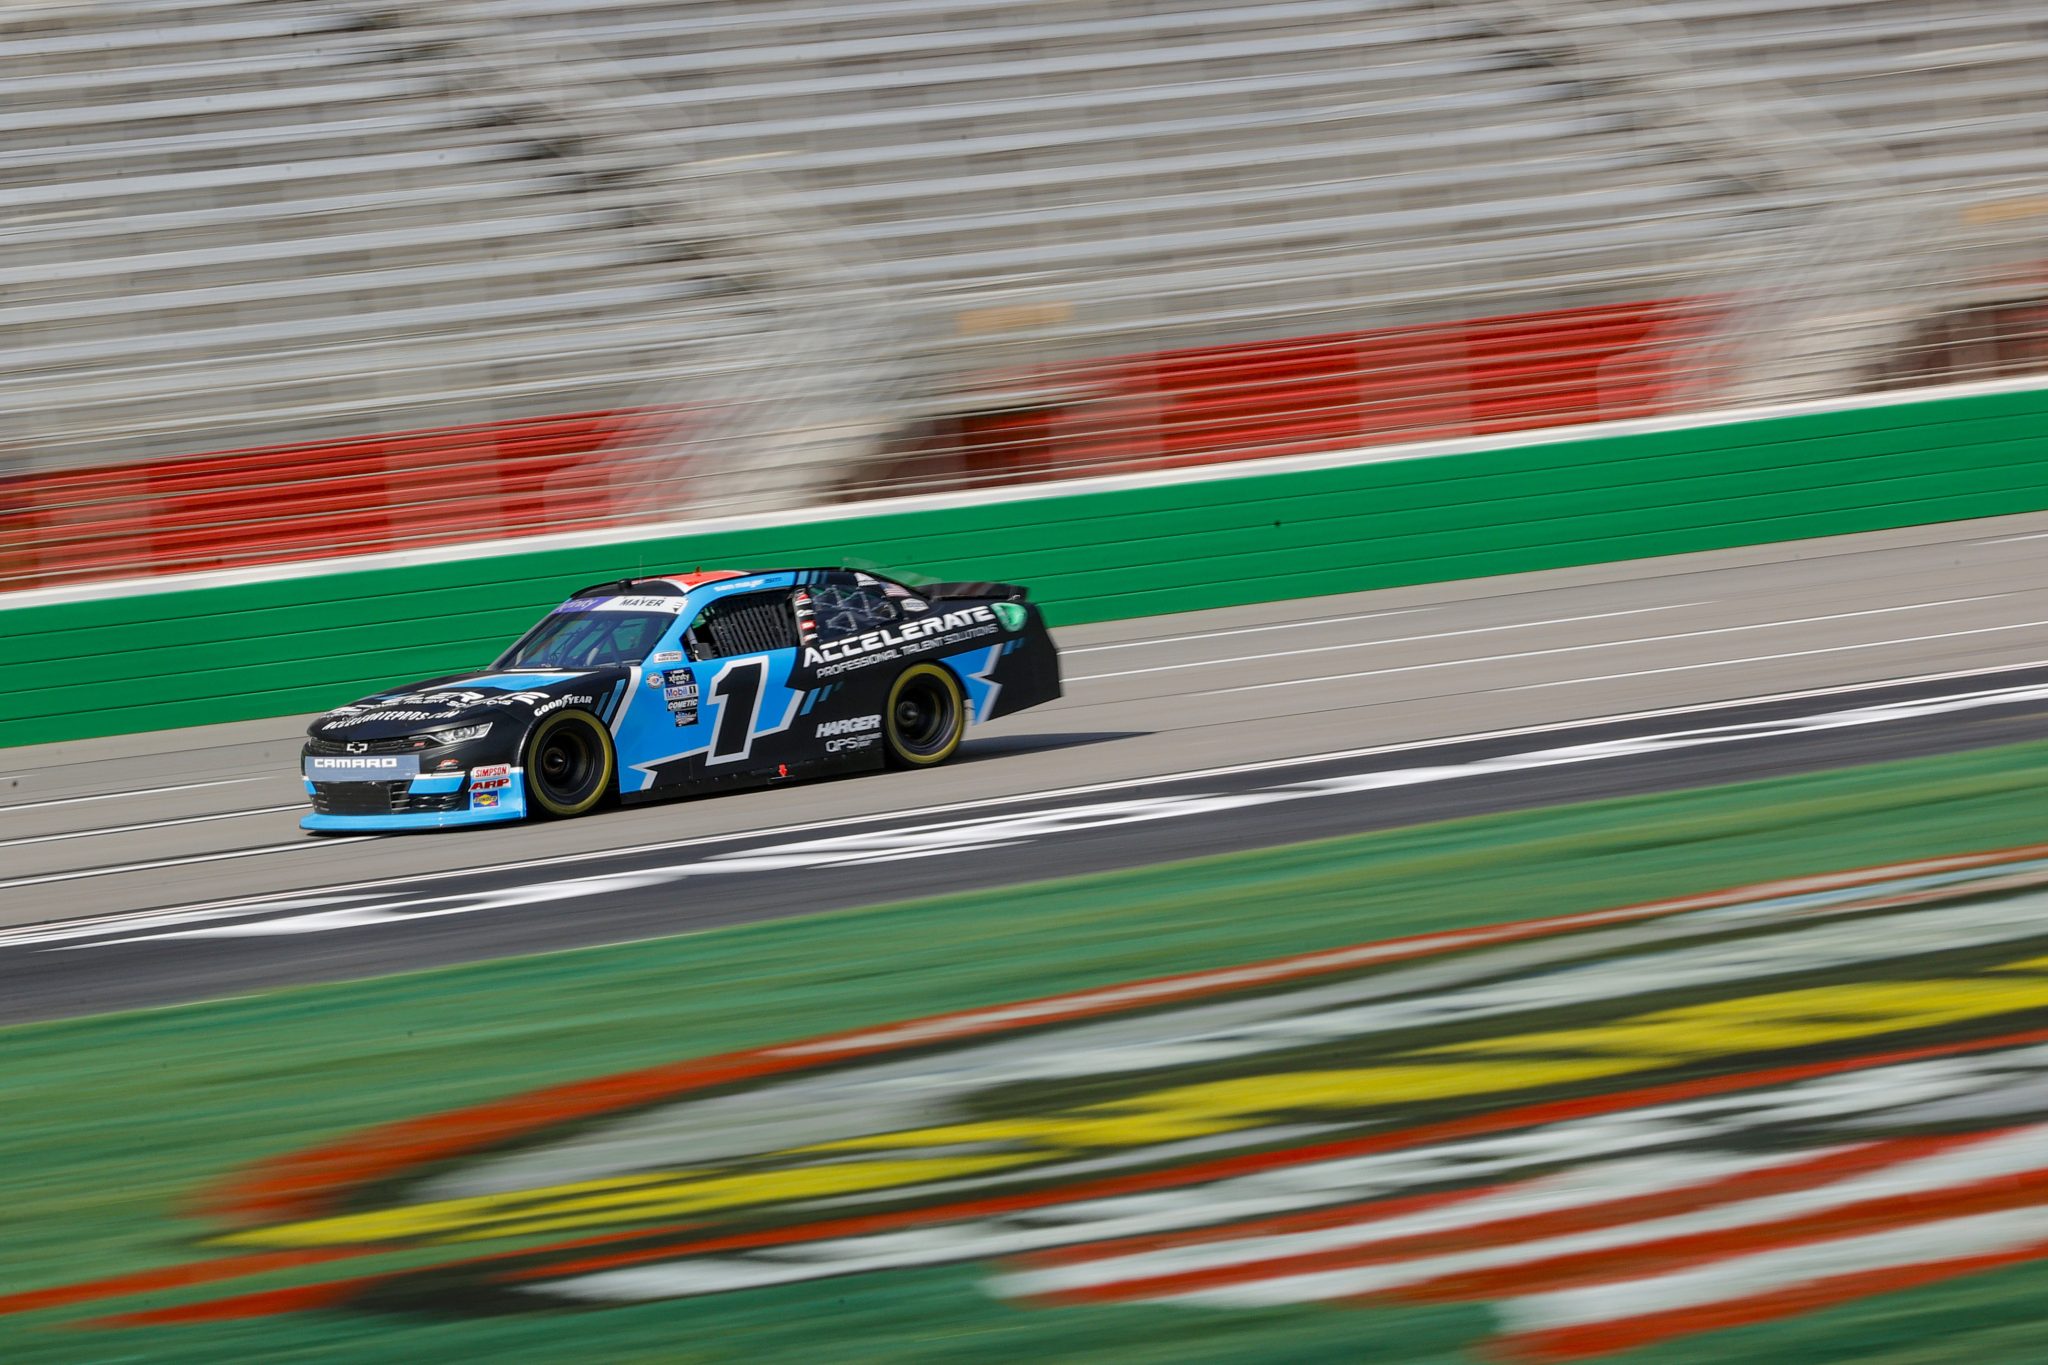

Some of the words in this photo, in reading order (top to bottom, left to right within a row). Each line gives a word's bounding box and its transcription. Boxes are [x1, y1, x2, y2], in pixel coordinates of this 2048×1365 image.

[619, 599, 665, 607] MAYER
[803, 605, 996, 667] ACCELERATE
[816, 650, 902, 678] PROFESSIONAL
[901, 638, 945, 656] TALENT
[943, 624, 999, 645] SOLUTIONS
[666, 688, 688, 697] Mobil
[534, 694, 593, 717] GOODYEAR
[668, 700, 698, 710] COMETIC
[706, 655, 769, 766] 1
[815, 714, 882, 738] HARGER
[314, 758, 397, 768] CAMARO
[475, 767, 507, 777] SIMPSON
[470, 778, 510, 790] ARP
